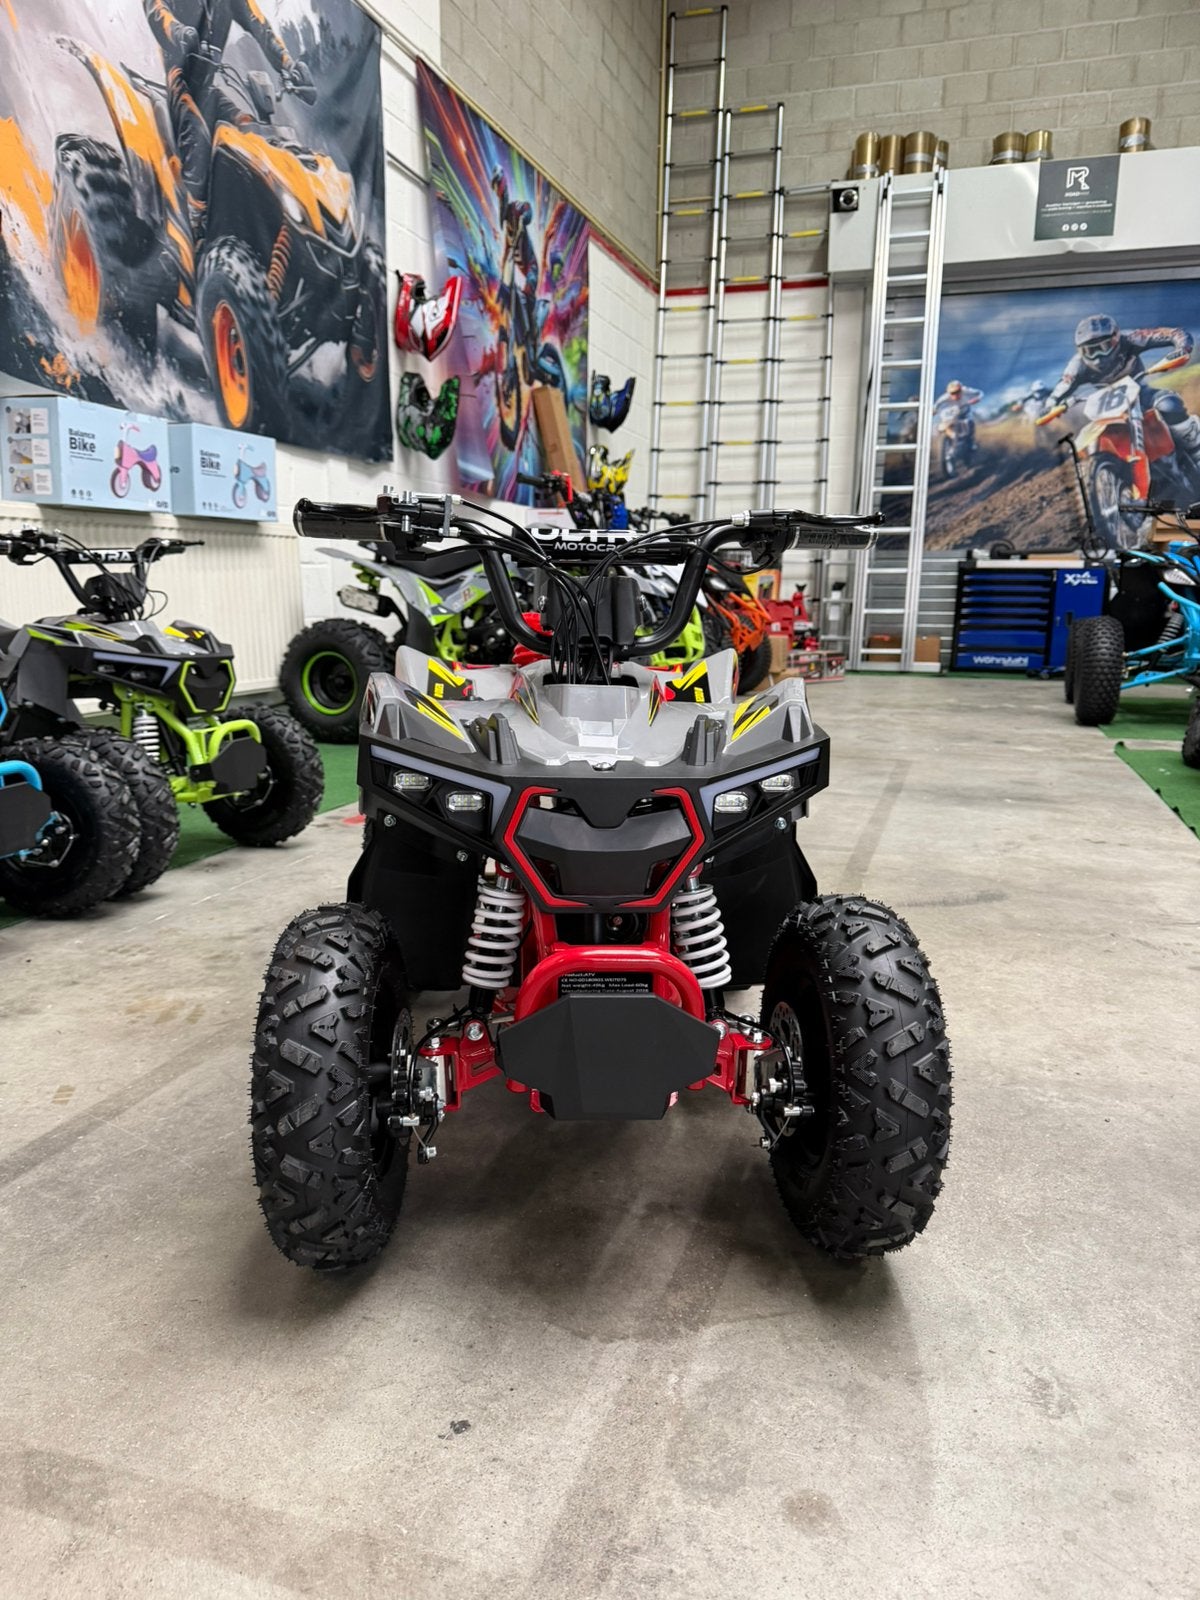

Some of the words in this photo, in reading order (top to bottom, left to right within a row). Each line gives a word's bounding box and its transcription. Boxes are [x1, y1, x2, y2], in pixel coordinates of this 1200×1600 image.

[69, 436, 97, 453] Bike
[200, 456, 221, 471] Bike
[554, 542, 647, 554] MOTOCRS
